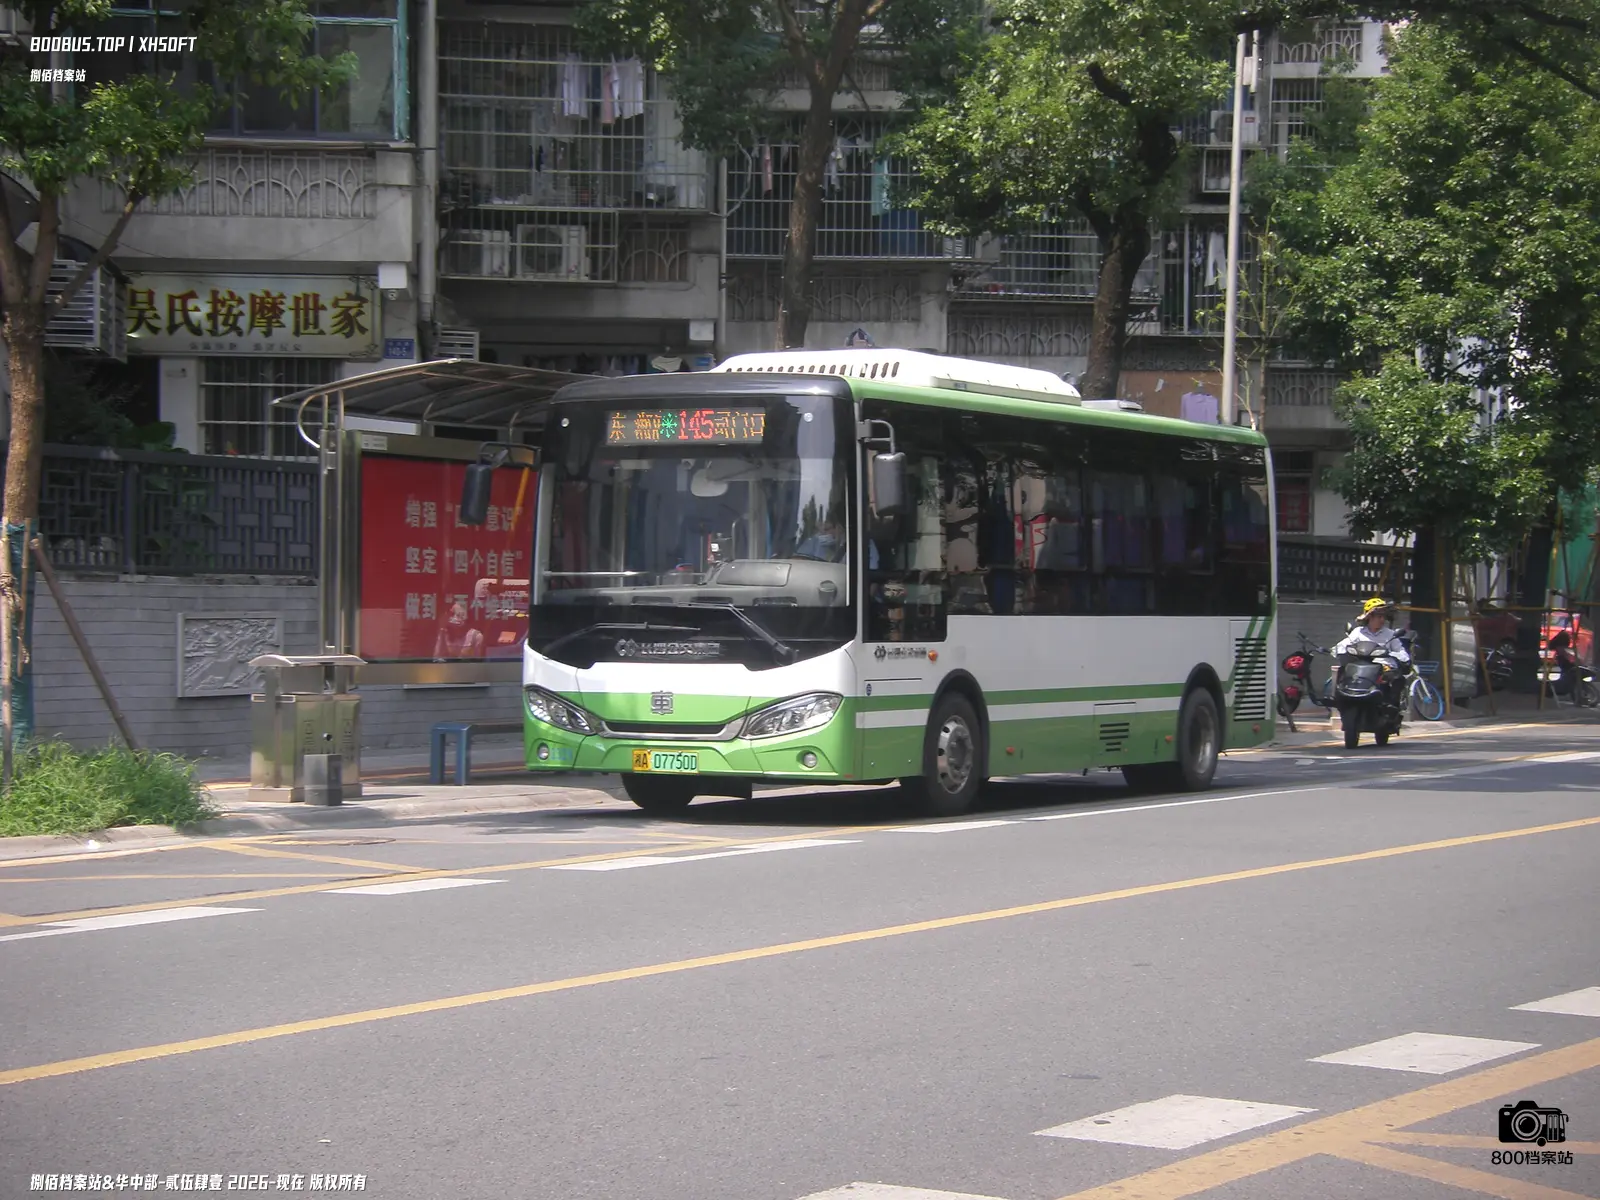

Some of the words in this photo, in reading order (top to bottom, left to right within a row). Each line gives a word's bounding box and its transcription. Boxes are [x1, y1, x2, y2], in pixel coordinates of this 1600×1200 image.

[127, 288, 369, 338] 吴氏按摩世家
[677, 409, 714, 440] 145
[405, 546, 437, 574] 坚定
